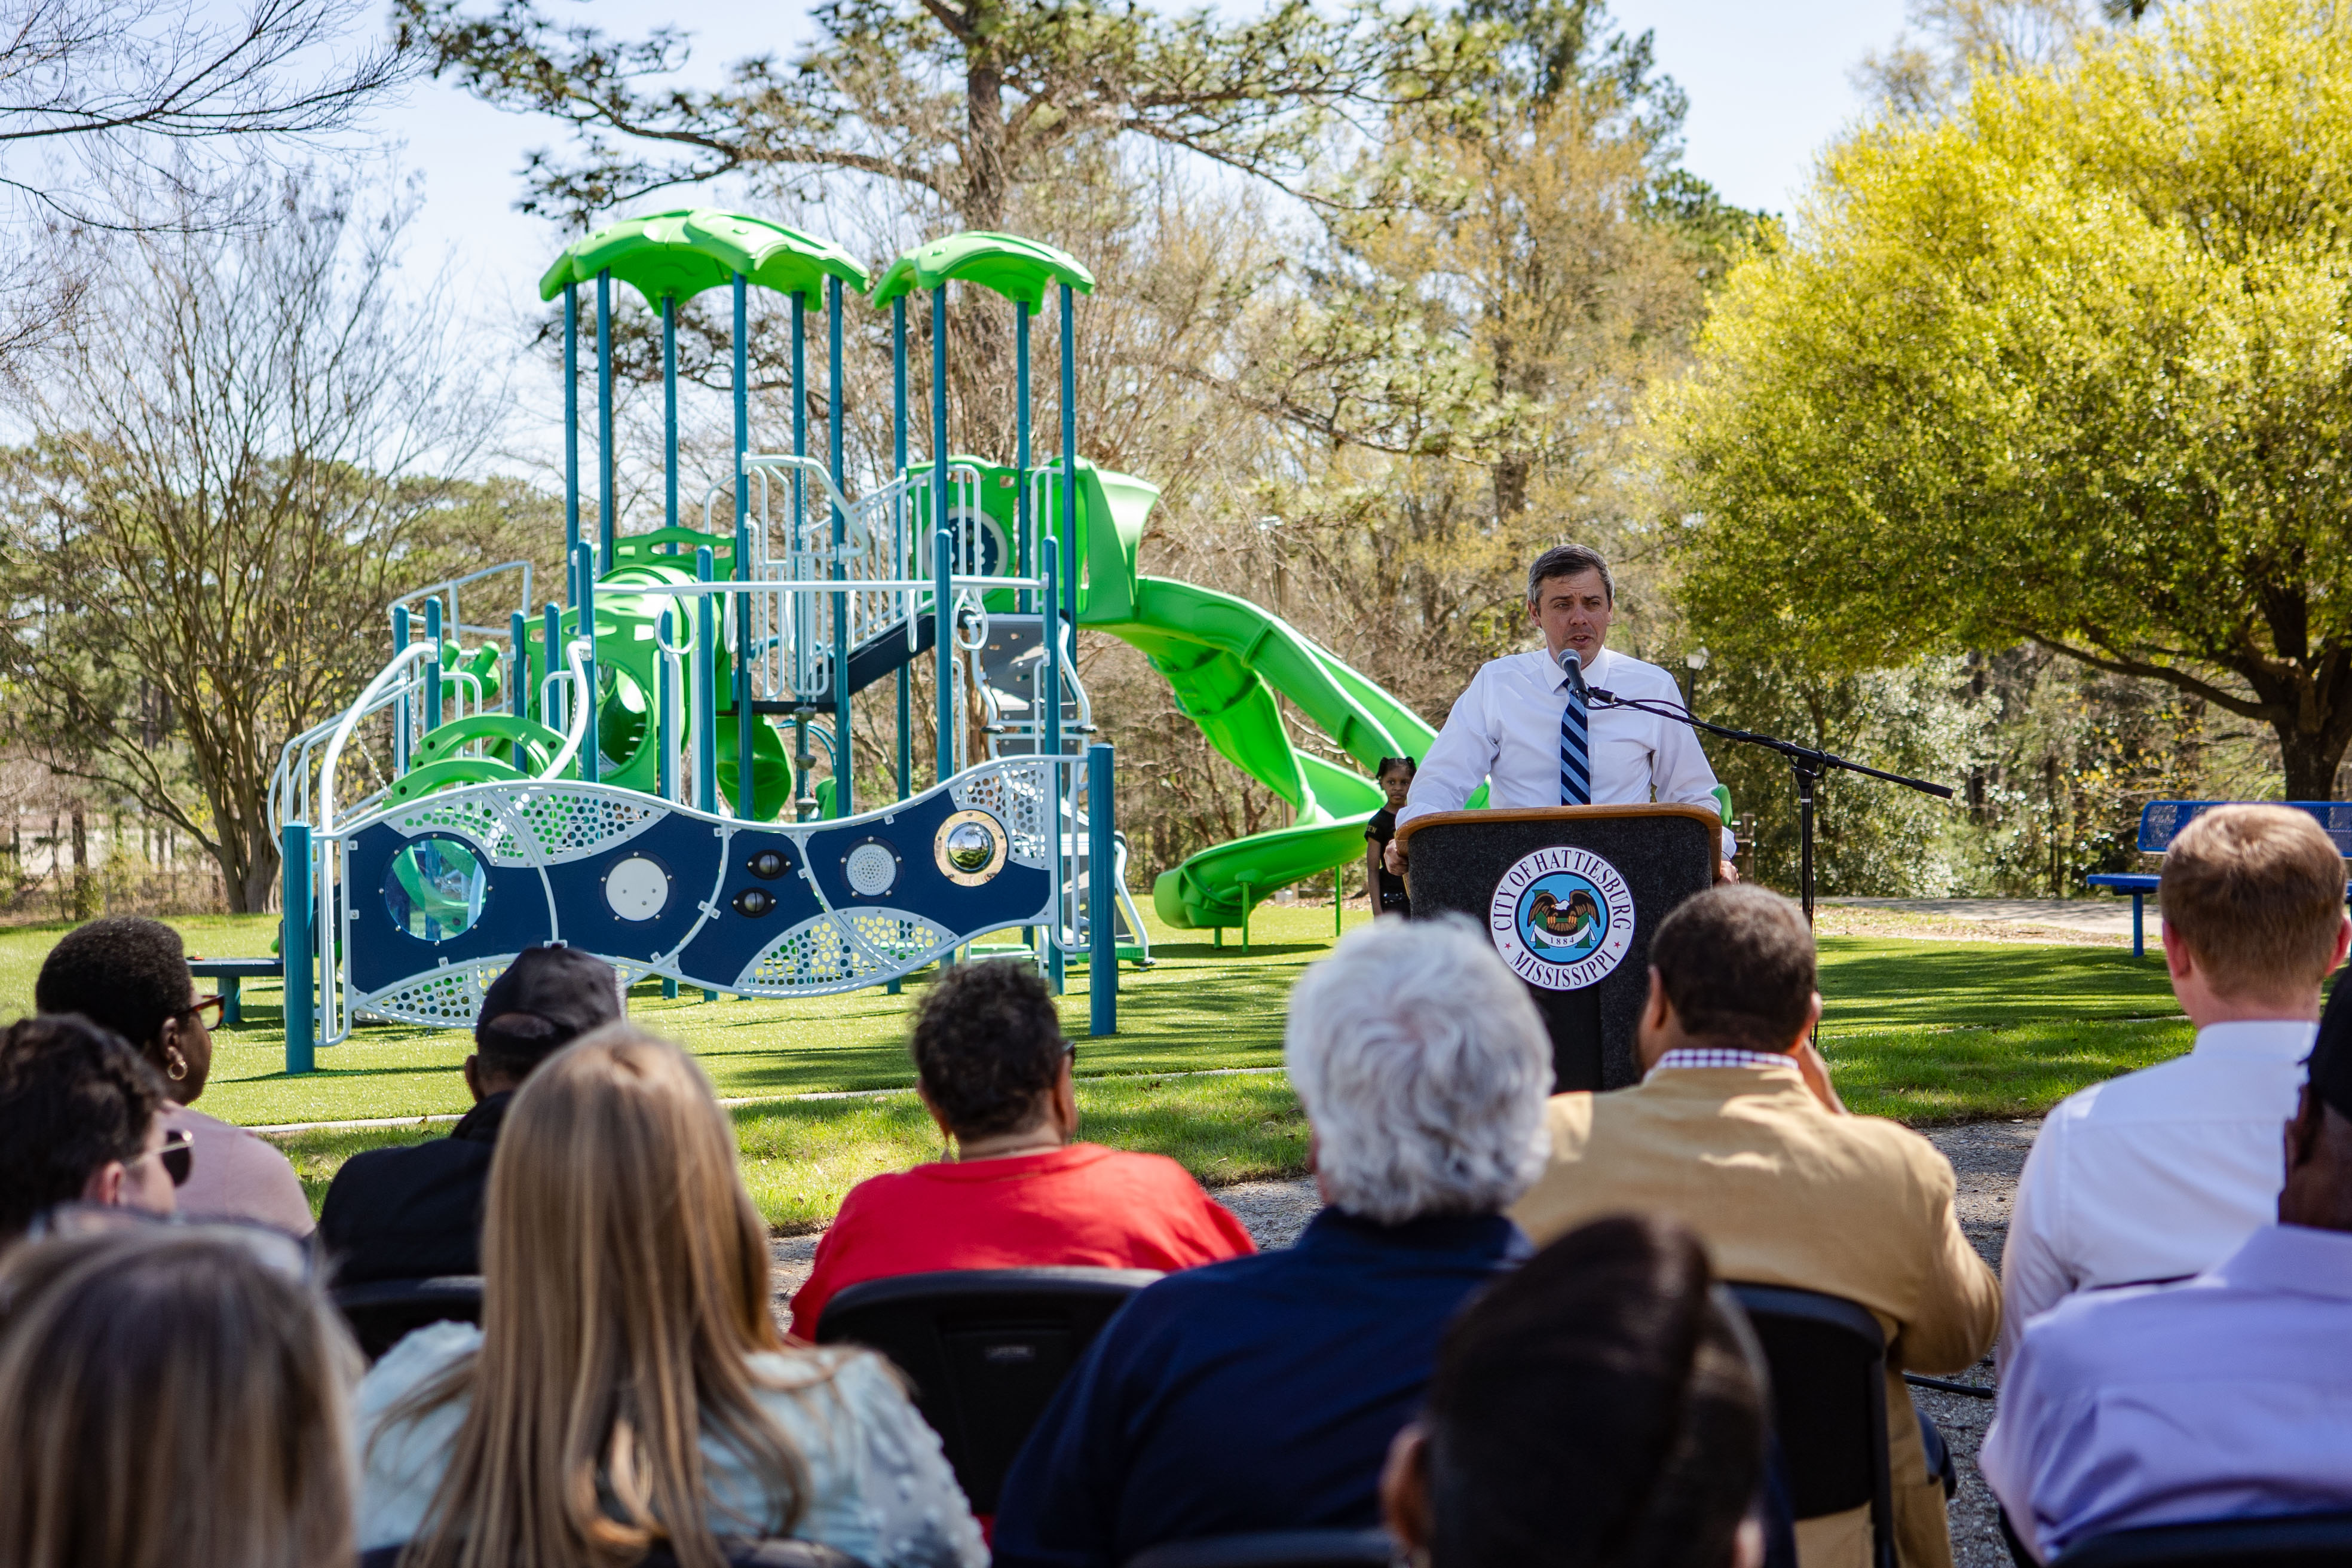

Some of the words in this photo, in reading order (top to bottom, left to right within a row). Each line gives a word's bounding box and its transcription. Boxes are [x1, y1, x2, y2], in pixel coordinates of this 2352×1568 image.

[1493, 886, 1517, 930] CITY
[1509, 861, 1533, 887] OF
[1533, 850, 1631, 930] HATTIESBURG
[1551, 936, 1575, 945] 1884
[1509, 949, 1618, 987] MISSISSIPPI
